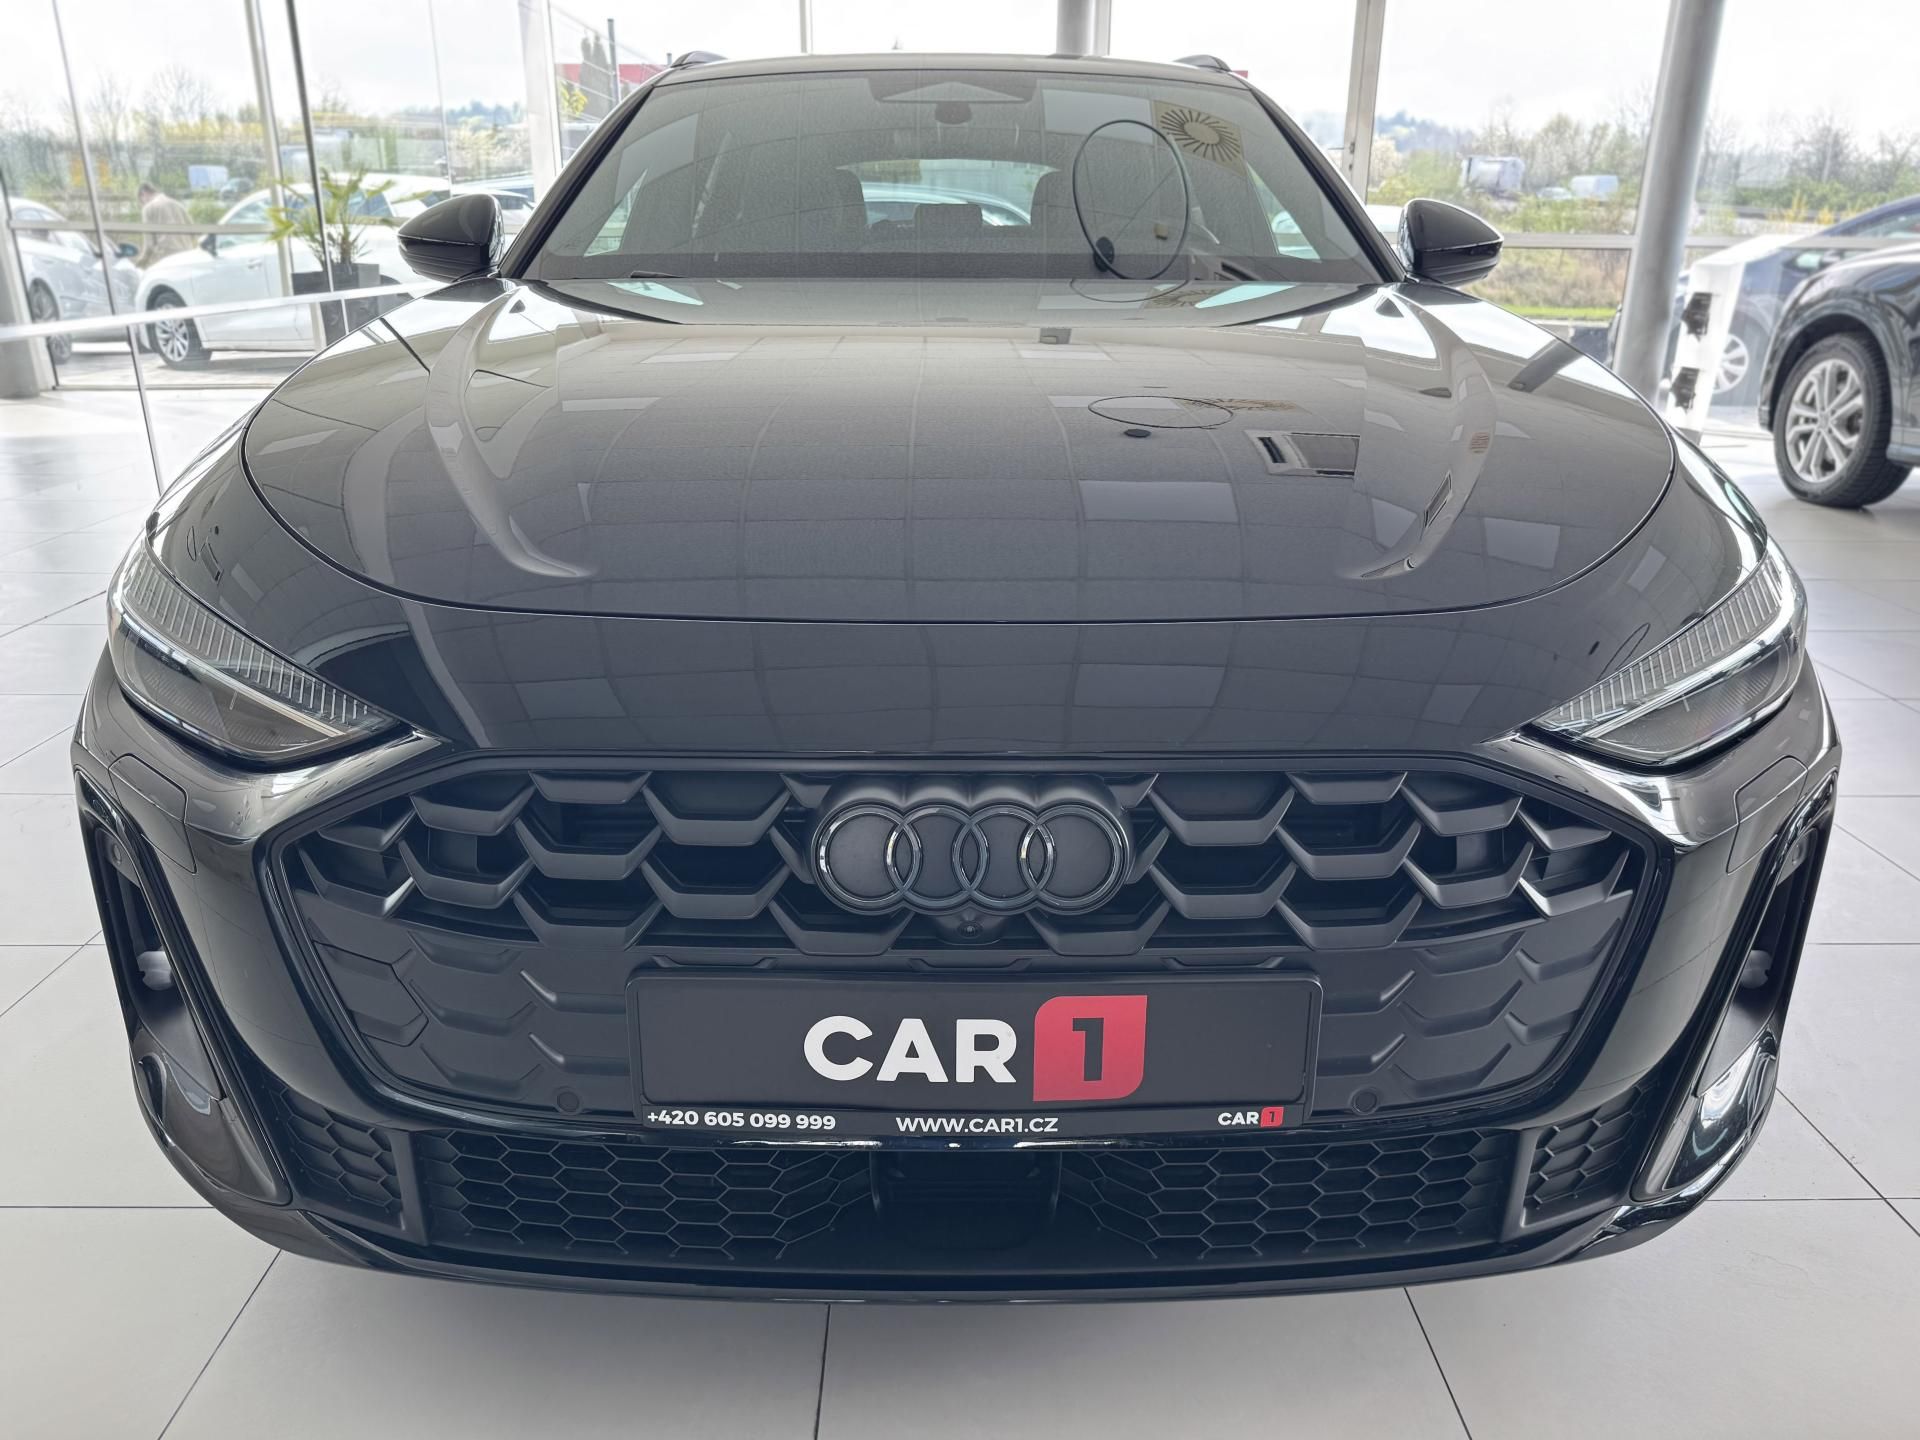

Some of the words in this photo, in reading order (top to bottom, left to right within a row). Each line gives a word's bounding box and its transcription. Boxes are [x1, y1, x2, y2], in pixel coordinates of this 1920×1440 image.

[803, 1014, 1017, 1083] CAR
[1071, 1016, 1105, 1082] 1
[647, 1109, 699, 1126] +420
[703, 1111, 745, 1127] 605
[749, 1112, 791, 1129] 099
[795, 1113, 836, 1130] 999
[895, 1116, 1059, 1133] WWW.CAR1.CZ
